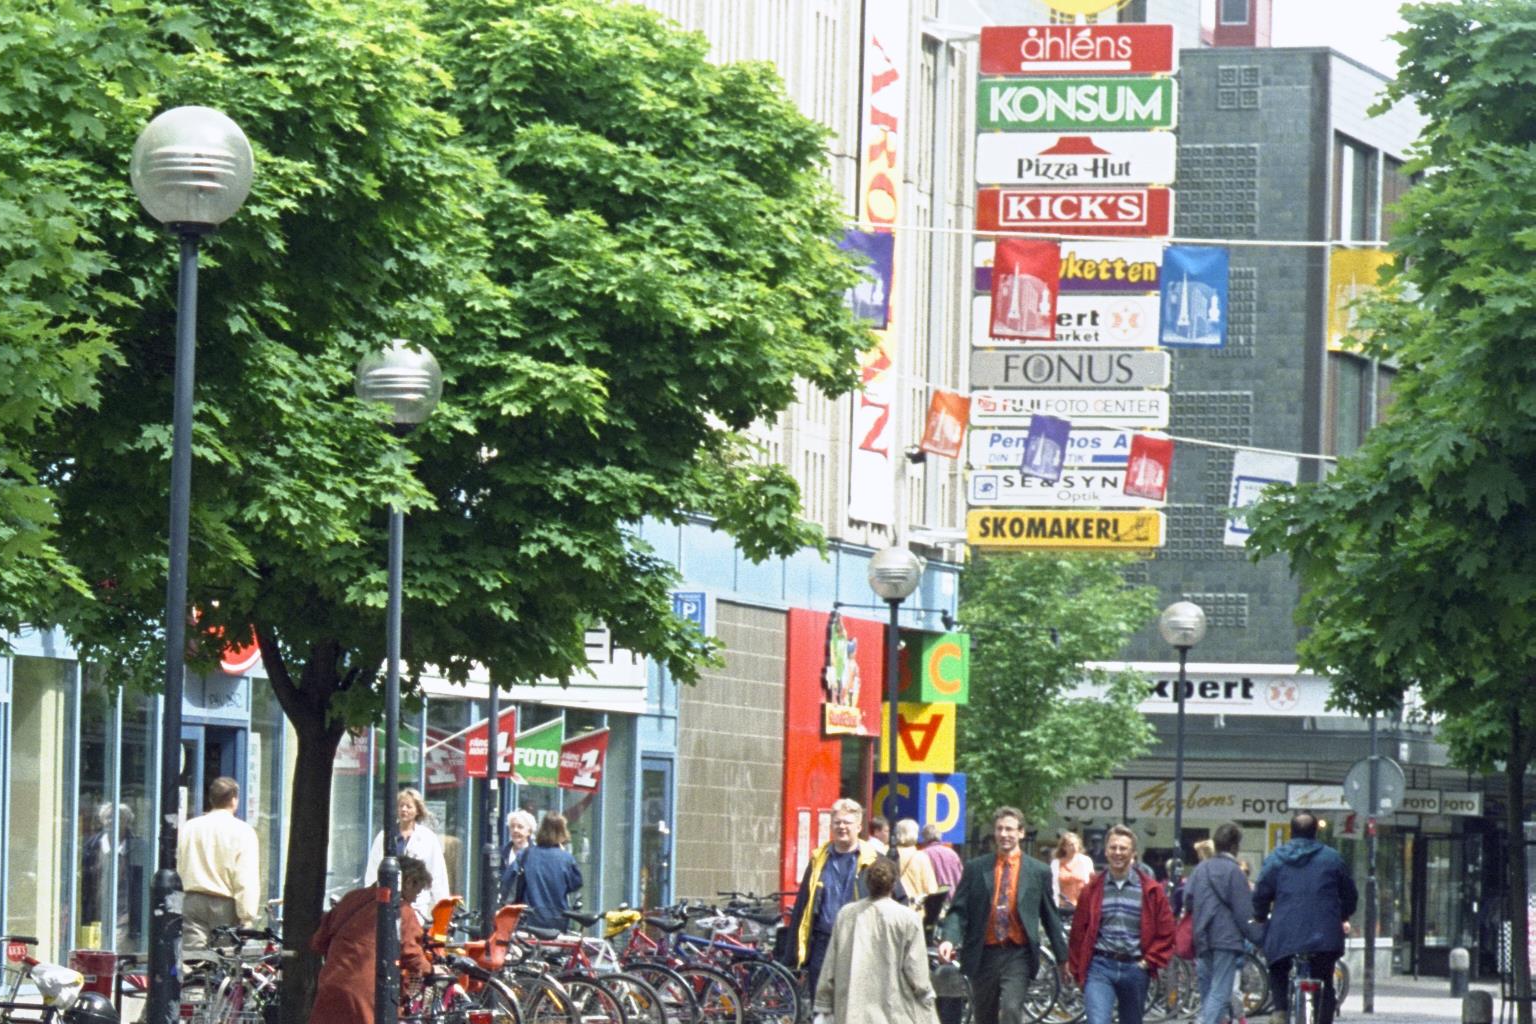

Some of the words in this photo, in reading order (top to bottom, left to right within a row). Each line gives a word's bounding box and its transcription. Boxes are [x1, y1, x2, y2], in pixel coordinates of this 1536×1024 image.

[1020, 27, 1132, 60] åhléns
[989, 85, 1162, 122] KONSUM
[1017, 158, 1078, 180] Pizza
[1083, 158, 1131, 178] Hut
[1006, 195, 1141, 220] KICK'S
[1003, 353, 1134, 384] FONUS
[1045, 400, 1089, 413] FOTO
[1094, 399, 1160, 414] CENTER
[1057, 490, 1100, 503] Optik
[928, 642, 962, 695] C
[1148, 677, 1254, 703] xpert
[897, 713, 944, 762] A
[515, 747, 559, 769] FOTO
[926, 782, 960, 833] D
[1066, 796, 1113, 811] FOTO
[1242, 799, 1289, 814] FOTO
[1403, 798, 1438, 809] FOTO
[1444, 799, 1475, 811] FOTO
